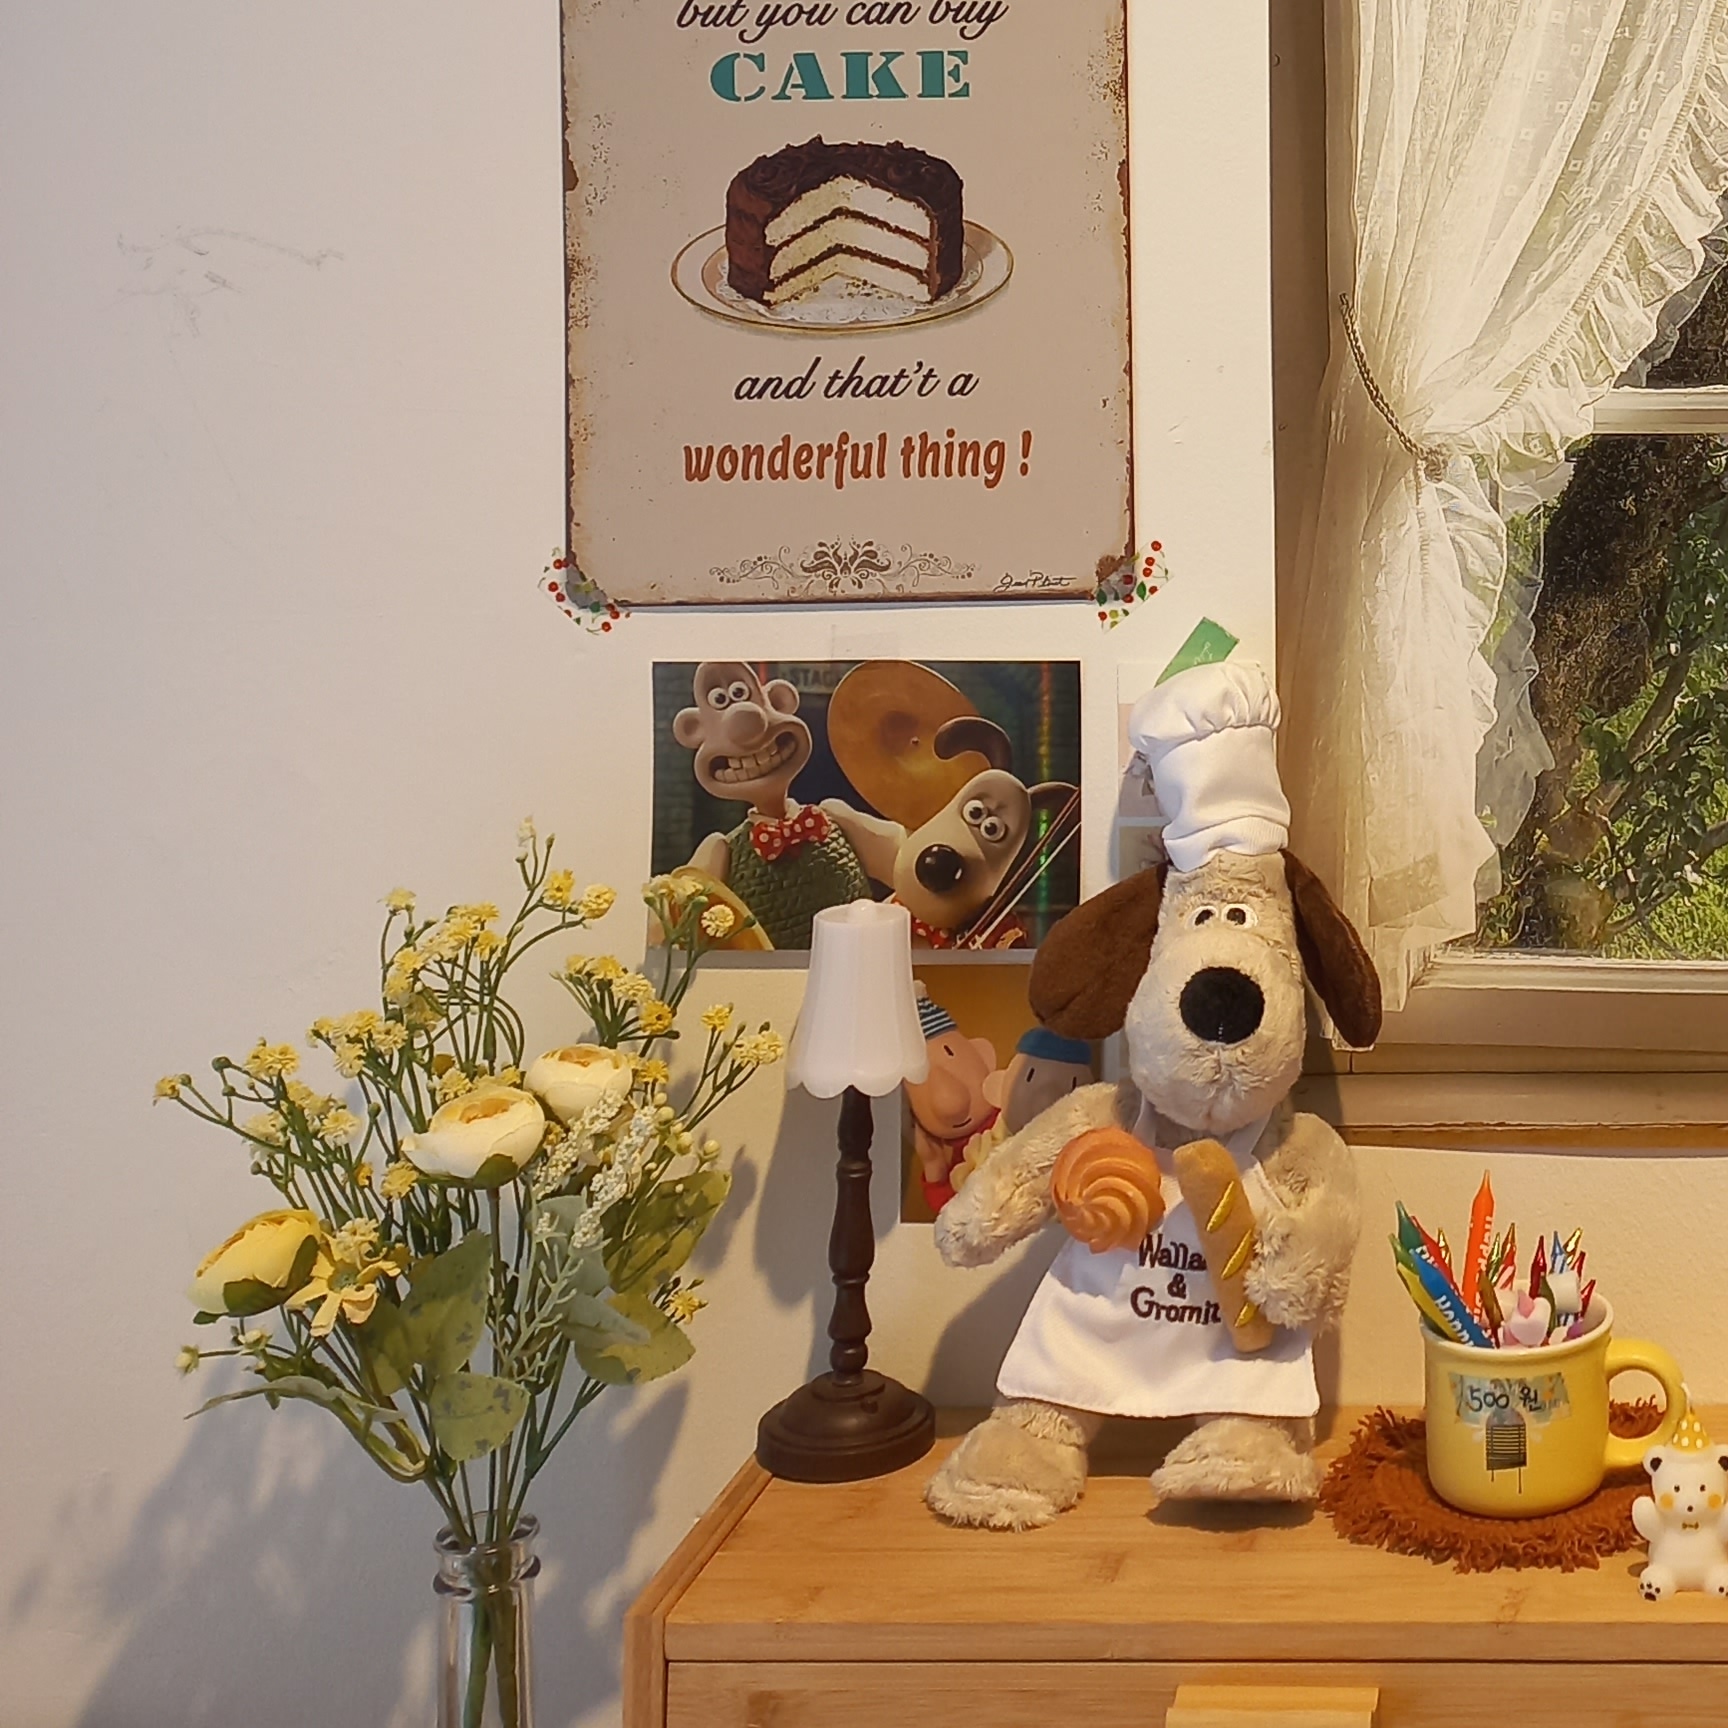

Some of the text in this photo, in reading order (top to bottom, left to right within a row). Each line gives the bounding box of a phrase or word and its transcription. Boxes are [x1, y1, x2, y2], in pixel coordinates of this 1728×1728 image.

[738, 1, 839, 44] you
[845, 0, 921, 26] can
[710, 49, 971, 103] CAKE
[733, 354, 980, 400] and that't a
[683, 430, 888, 490] wonderful
[1138, 1233, 1207, 1271] Walla
[1130, 1285, 1222, 1326] Gromit
[1166, 1272, 1187, 1300] &
[1468, 1384, 1542, 1412] 500 원
